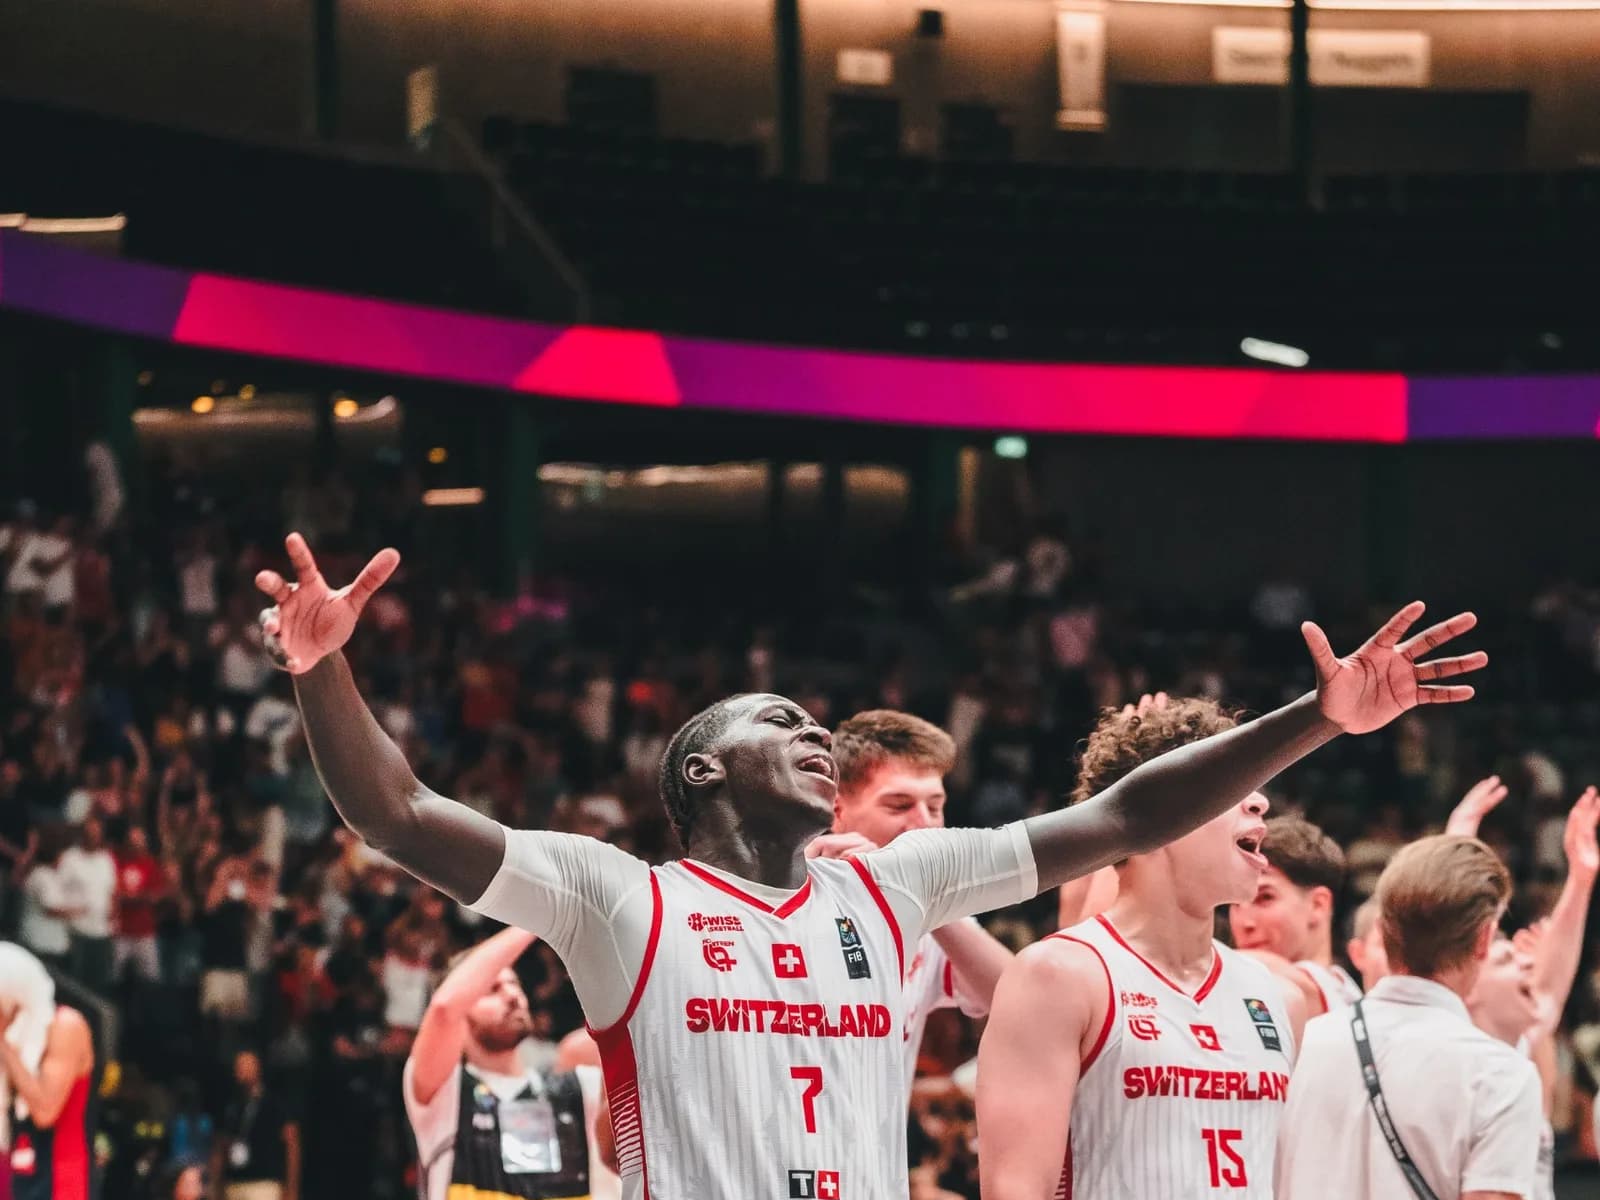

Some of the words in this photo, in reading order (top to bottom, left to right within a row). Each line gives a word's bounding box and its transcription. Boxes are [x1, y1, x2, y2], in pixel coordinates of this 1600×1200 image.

[848, 951, 863, 963] FIB
[685, 998, 891, 1037] SWITZERLAND
[790, 1066, 823, 1133] 7
[1202, 1128, 1248, 1188] 15
[789, 1171, 815, 1198] T
